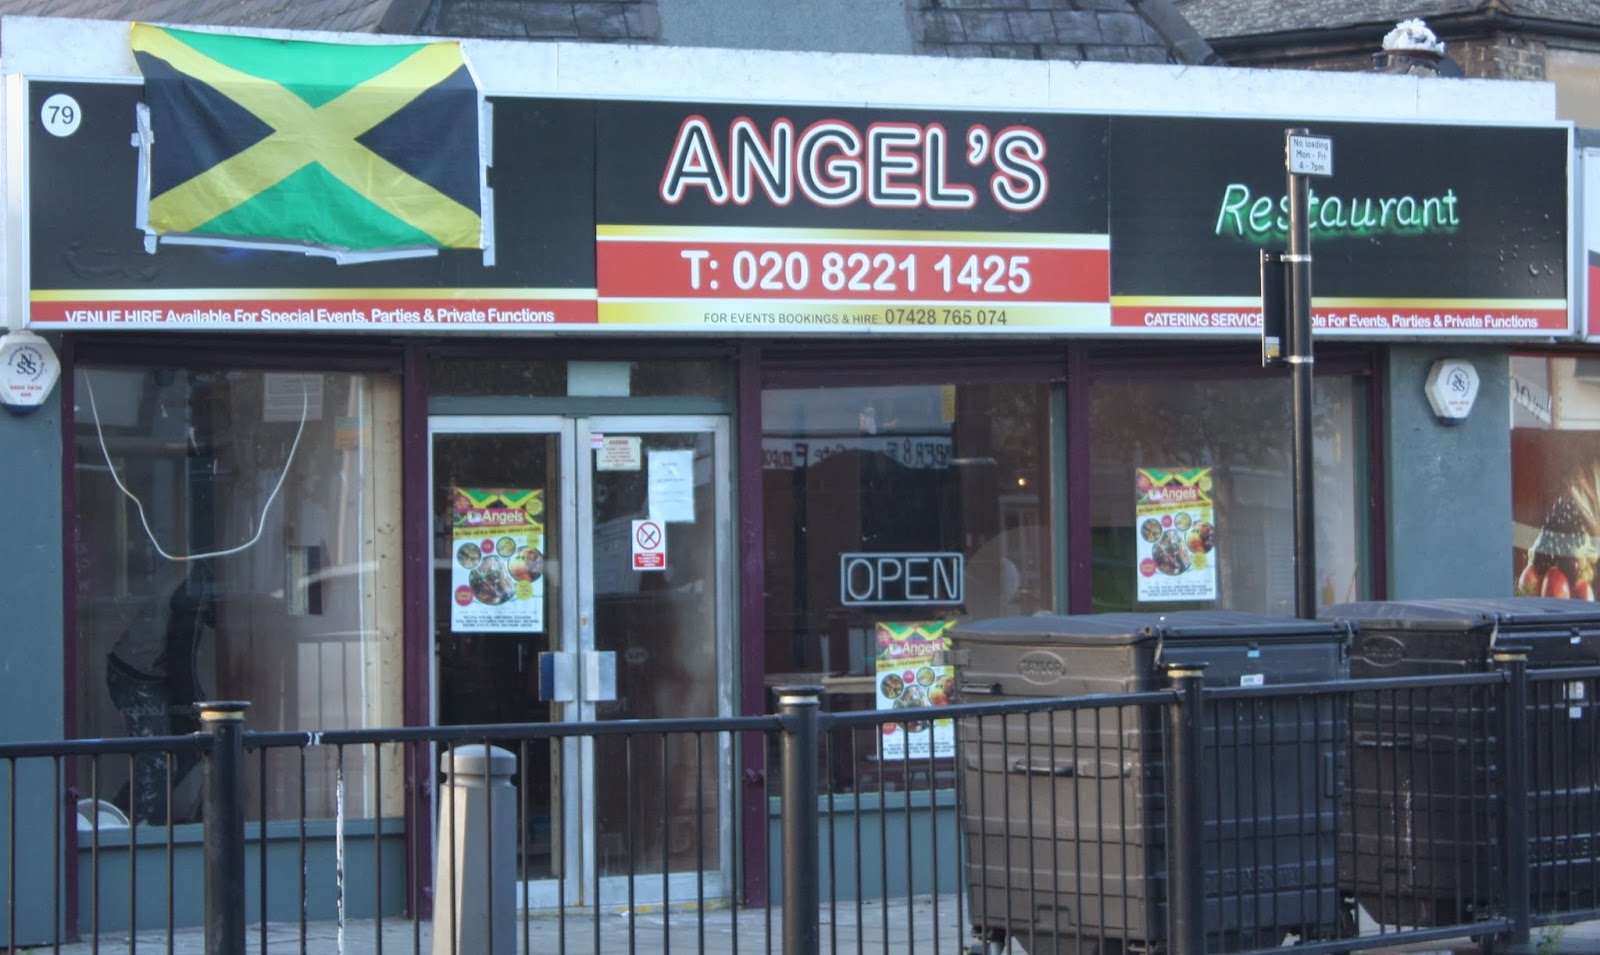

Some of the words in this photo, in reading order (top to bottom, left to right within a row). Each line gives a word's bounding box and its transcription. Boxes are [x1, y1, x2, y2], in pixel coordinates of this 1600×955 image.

[48, 105, 74, 125] 79
[1293, 138, 1303, 147] No
[1304, 139, 1329, 151] loading
[1296, 149, 1310, 159] Mon
[1317, 151, 1326, 160] Fri
[660, 115, 1049, 211] ANGEL'S
[1311, 161, 1325, 172] 7pm
[681, 249, 719, 290] T:
[732, 250, 810, 291] 020
[821, 252, 917, 292] 8221
[934, 254, 1031, 293] 1425
[124, 310, 162, 322] HIRE
[166, 309, 231, 323] Available
[234, 309, 258, 322] For
[260, 308, 314, 323] Special
[371, 308, 420, 323] Parties
[423, 309, 435, 322] &
[437, 308, 485, 322] Private
[487, 307, 555, 322] Functions
[703, 312, 728, 324] FOR
[731, 312, 775, 324] EVENTS
[778, 312, 839, 324] BOOKINGS
[841, 313, 850, 324] &
[852, 313, 882, 325] HIRE:
[884, 308, 937, 325] 07428
[942, 309, 972, 325] 765
[976, 309, 1007, 325] 074
[1144, 312, 1209, 327] CATERING
[1328, 313, 1347, 327] For
[1349, 313, 1390, 329] Events,
[1392, 314, 1432, 328] Parties
[1433, 314, 1443, 328] &
[1444, 314, 1483, 328] Private
[1484, 314, 1538, 328] Functions
[1161, 486, 1197, 502] Angels
[481, 509, 524, 525] Angels
[847, 558, 958, 600] OPEN
[902, 641, 941, 656] Angels
